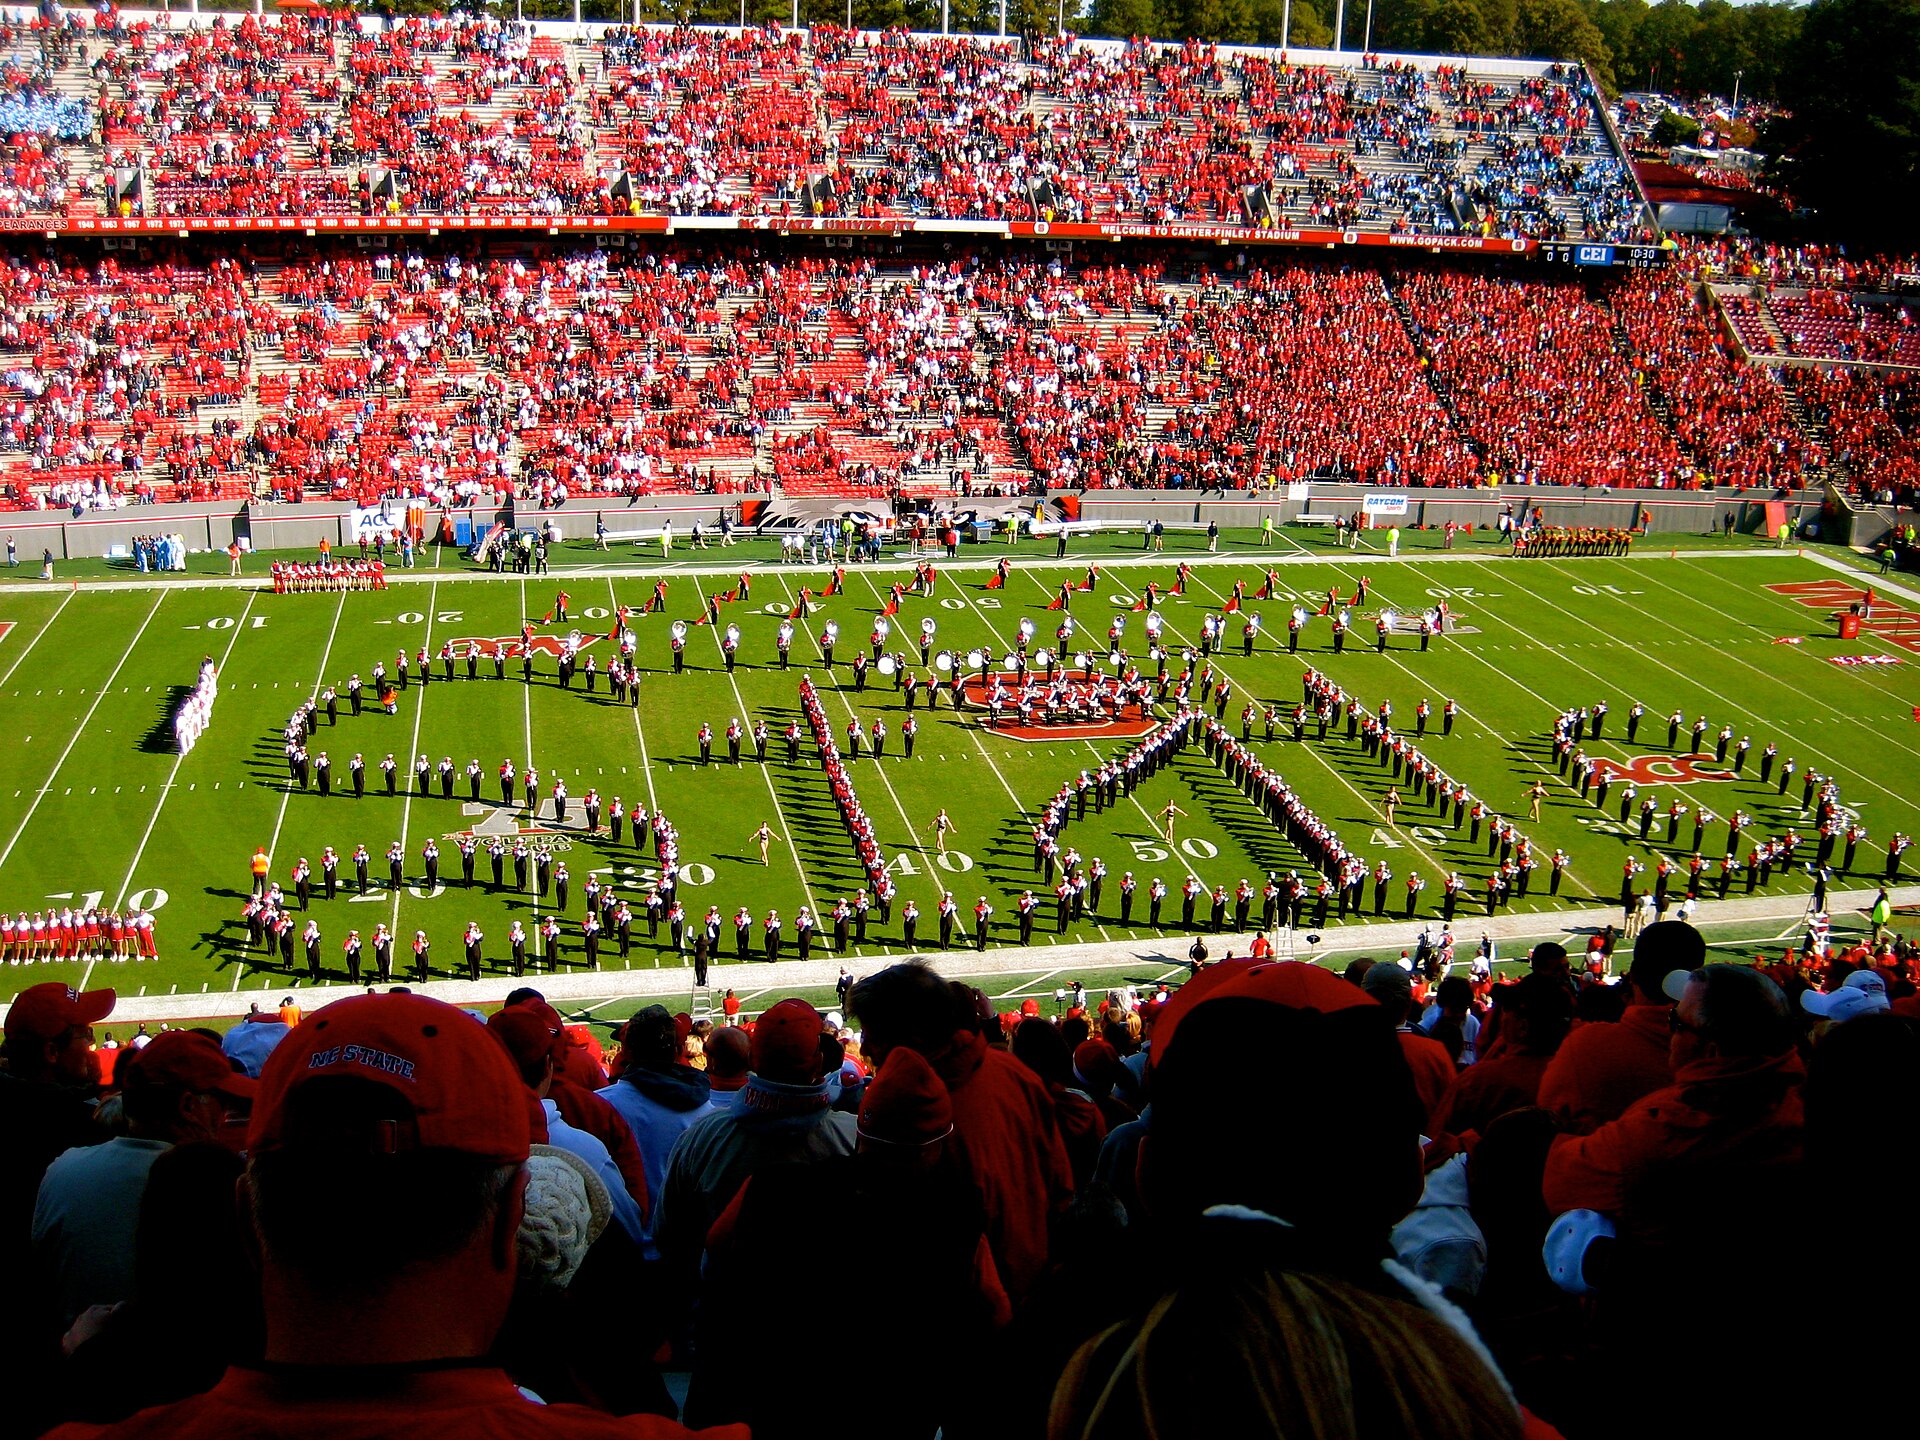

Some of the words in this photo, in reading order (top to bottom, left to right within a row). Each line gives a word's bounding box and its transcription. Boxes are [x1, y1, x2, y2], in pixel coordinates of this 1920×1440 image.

[145, 220, 163, 229] 1972
[168, 220, 186, 228] 1973
[190, 220, 208, 228] 1974
[213, 220, 230, 228] 1975
[235, 220, 252, 228] 1977
[364, 219, 380, 227] 1991
[385, 219, 402, 227] 1992
[406, 219, 423, 227] 1993
[427, 219, 444, 227] 1994
[469, 219, 486, 227] 2000
[490, 218, 506, 227] 2001
[510, 218, 527, 226] 2002
[593, 218, 609, 226] 2010
[1100, 225, 1151, 236] WELCOME
[1154, 227, 1168, 236] TO
[1171, 227, 1251, 238] CARTER-FINLEY
[1254, 230, 1300, 240] STADIUM
[1389, 236, 1483, 248] WWW.GOPACK.COM
[1547, 252, 1553, 262] 0
[1562, 253, 1569, 262] 0
[1580, 247, 1607, 261] CEI
[1630, 249, 1655, 259] 10:30
[359, 513, 396, 528] ACC
[940, 597, 1008, 610] 50
[207, 616, 272, 630] 10
[397, 611, 464, 625] 20
[1582, 752, 1742, 789] ACC
[460, 797, 601, 837] 75
[1369, 826, 1448, 849] 40
[1129, 838, 1219, 862] 50
[885, 850, 974, 876] 40
[621, 863, 715, 889] 30
[81, 888, 169, 917] 10
[307, 1046, 340, 1069] NC
[342, 1044, 415, 1079] STATE
